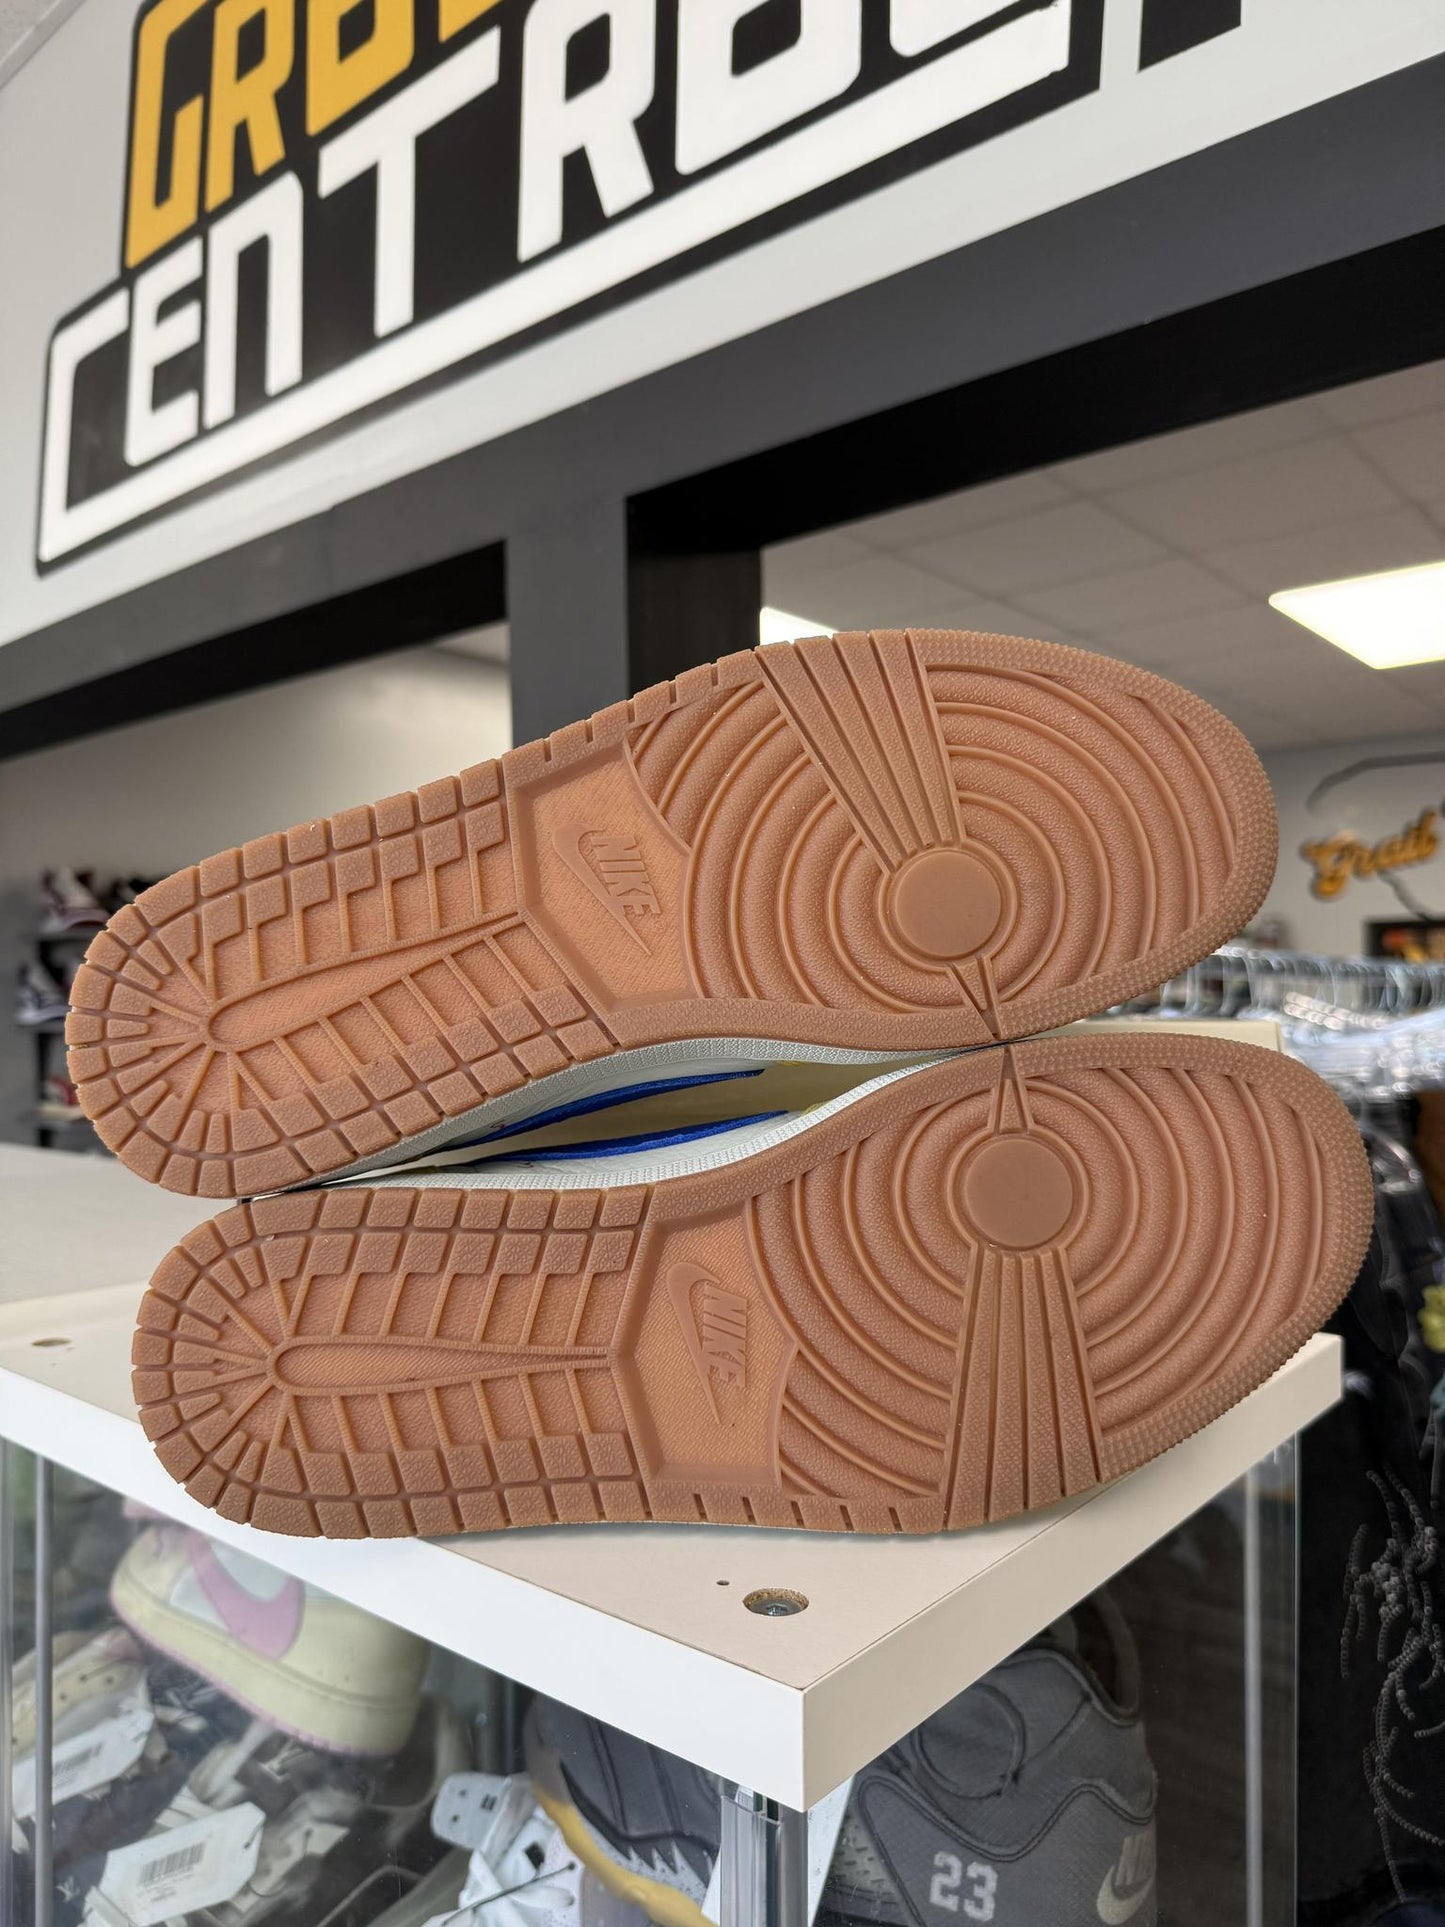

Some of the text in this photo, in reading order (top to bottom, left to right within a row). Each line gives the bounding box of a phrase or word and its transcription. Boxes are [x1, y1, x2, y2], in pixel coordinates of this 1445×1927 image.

[589, 834, 662, 916] NIKE
[701, 1281, 747, 1388] NIKE
[929, 1850, 998, 1921] 23
